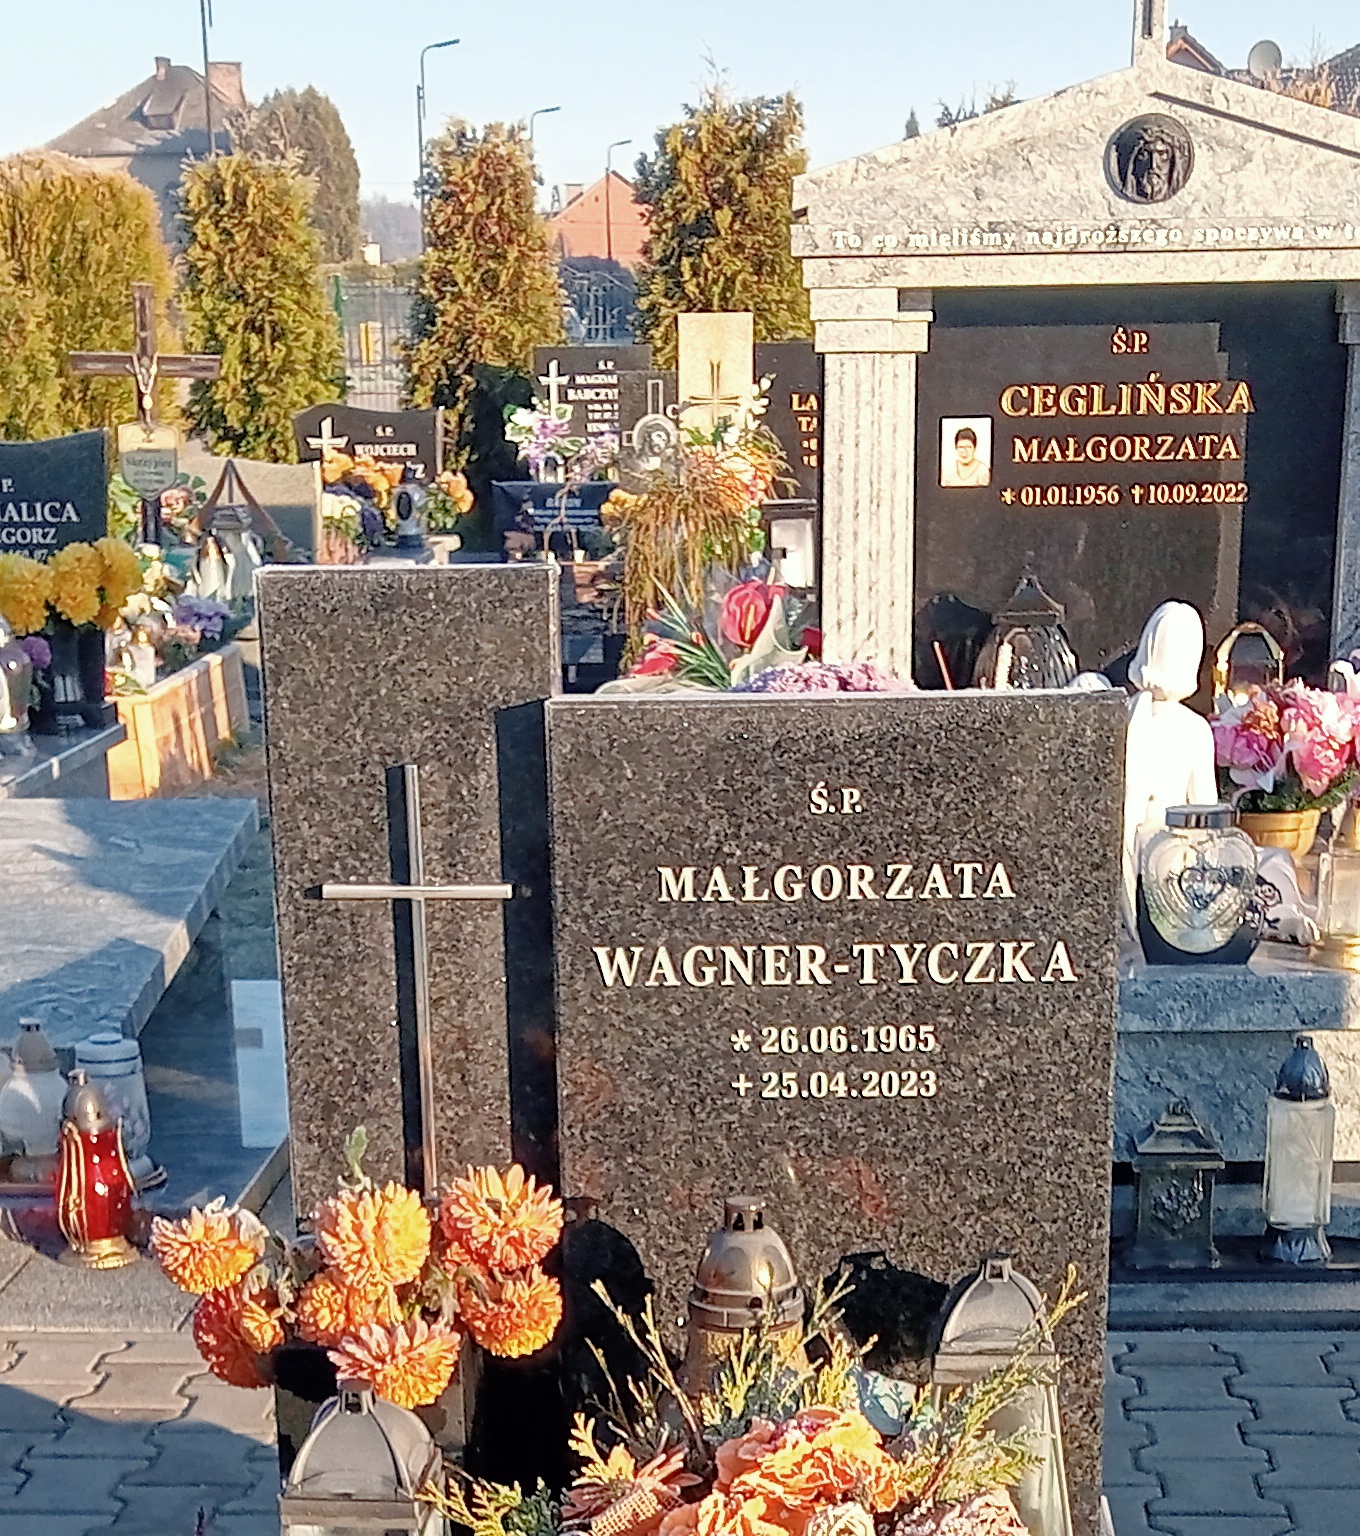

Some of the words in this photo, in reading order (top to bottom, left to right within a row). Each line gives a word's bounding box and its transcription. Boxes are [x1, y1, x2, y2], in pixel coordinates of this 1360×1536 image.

[832, 230, 861, 249] To
[872, 233, 898, 248] co
[908, 227, 1016, 249] mieliśmy
[1026, 224, 1183, 247] najdroższego
[1194, 221, 1304, 244] spoczywa
[1316, 225, 1335, 240] w
[1001, 371, 1256, 416] CEGLIŃSKA
[1013, 435, 1240, 463] MAŁGORZATA
[1021, 485, 1120, 505] 01.01.1956
[1148, 483, 1249, 505] 10.09.2022
[656, 862, 1016, 902] MAŁGORZATA
[593, 941, 1078, 987] WAGNER-TYCZKA
[761, 1024, 936, 1053] 26.06.1965
[761, 1070, 937, 1099] 25.04.2023
